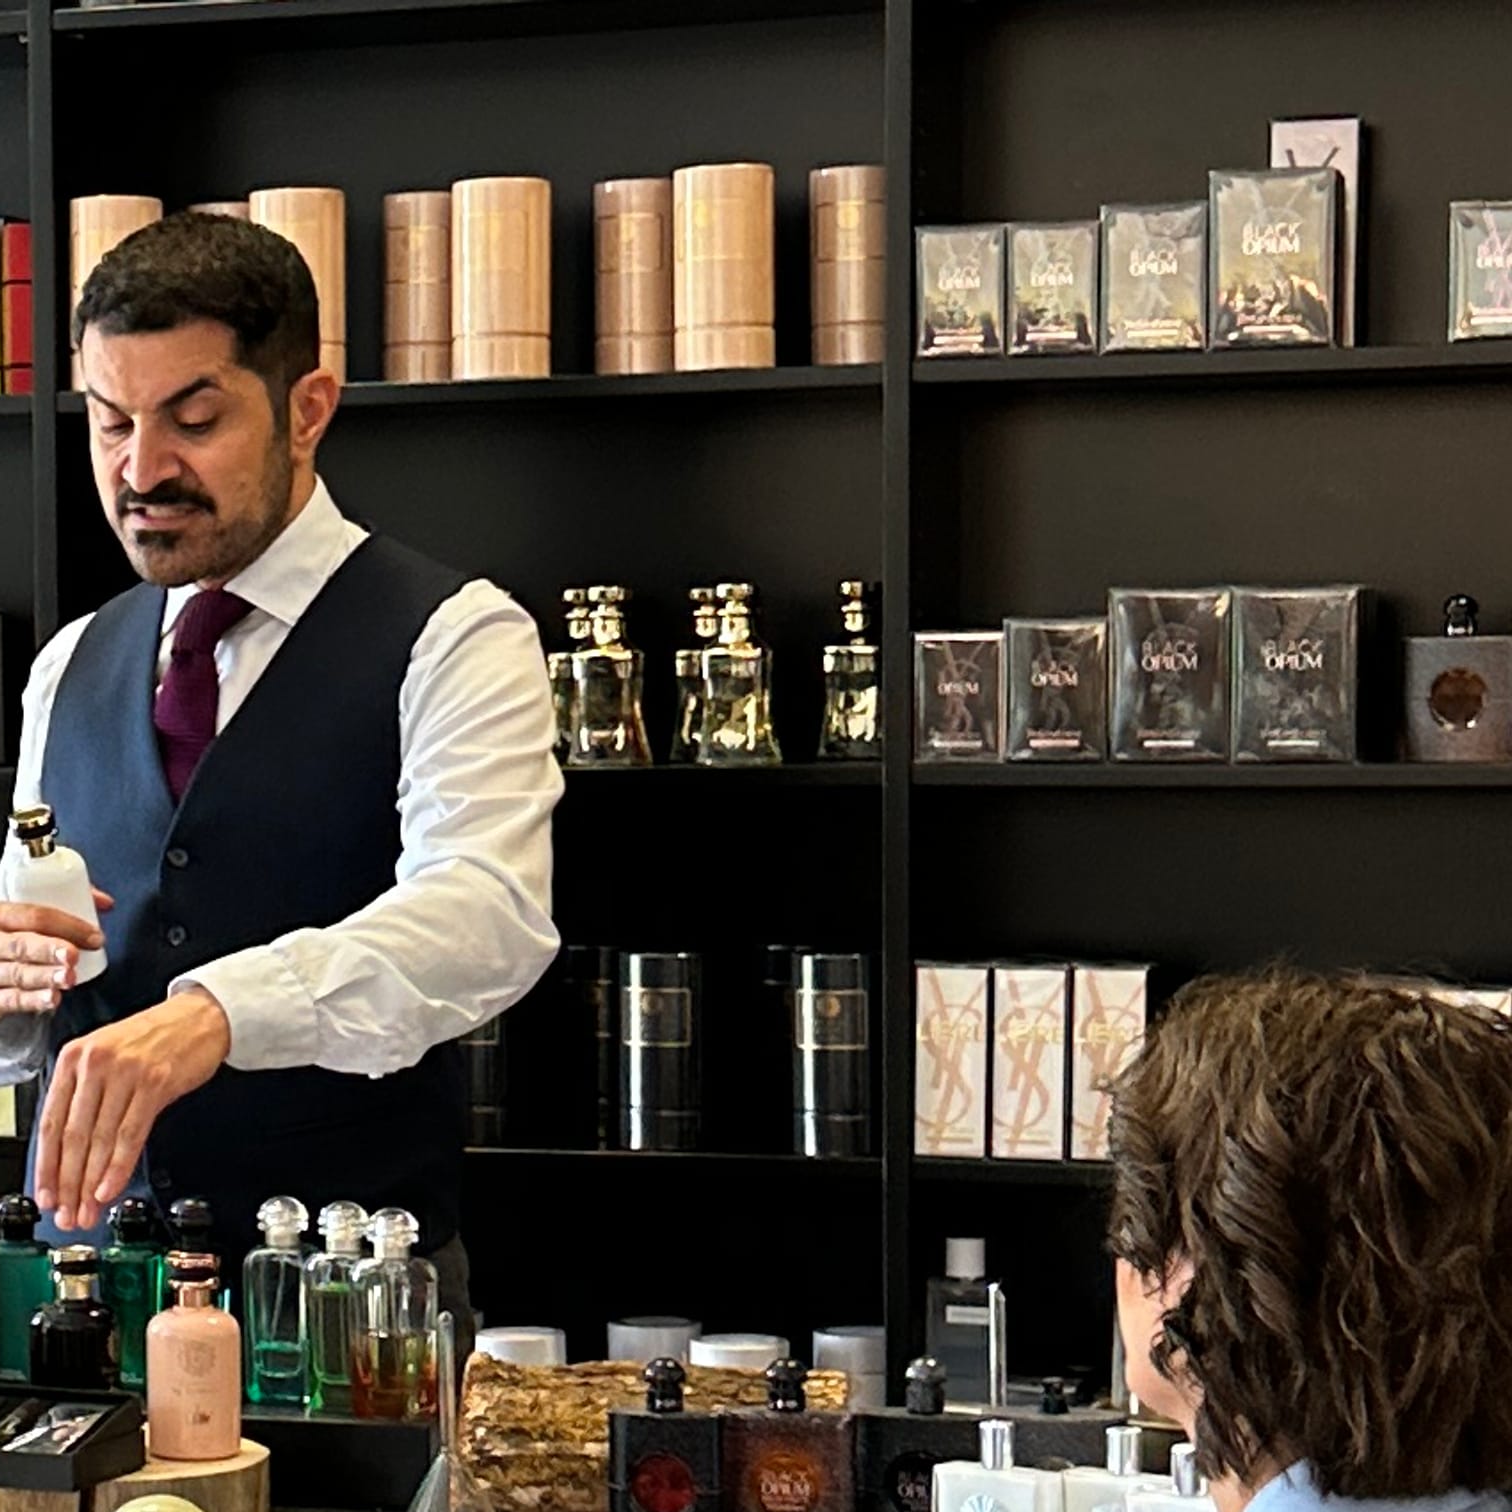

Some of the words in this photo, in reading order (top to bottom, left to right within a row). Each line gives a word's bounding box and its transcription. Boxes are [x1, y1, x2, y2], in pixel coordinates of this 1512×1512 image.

[1243, 222, 1301, 239] BLACK
[1241, 236, 1300, 256] OPIUM
[1128, 260, 1179, 277] OPIUM
[1141, 640, 1198, 655] BLACK
[1265, 639, 1323, 654] BLACK
[1141, 653, 1198, 671] OPIUM
[1265, 653, 1323, 671] OPIUM
[1031, 671, 1078, 688] OPIUM
[761, 1481, 811, 1497] OPIUM
